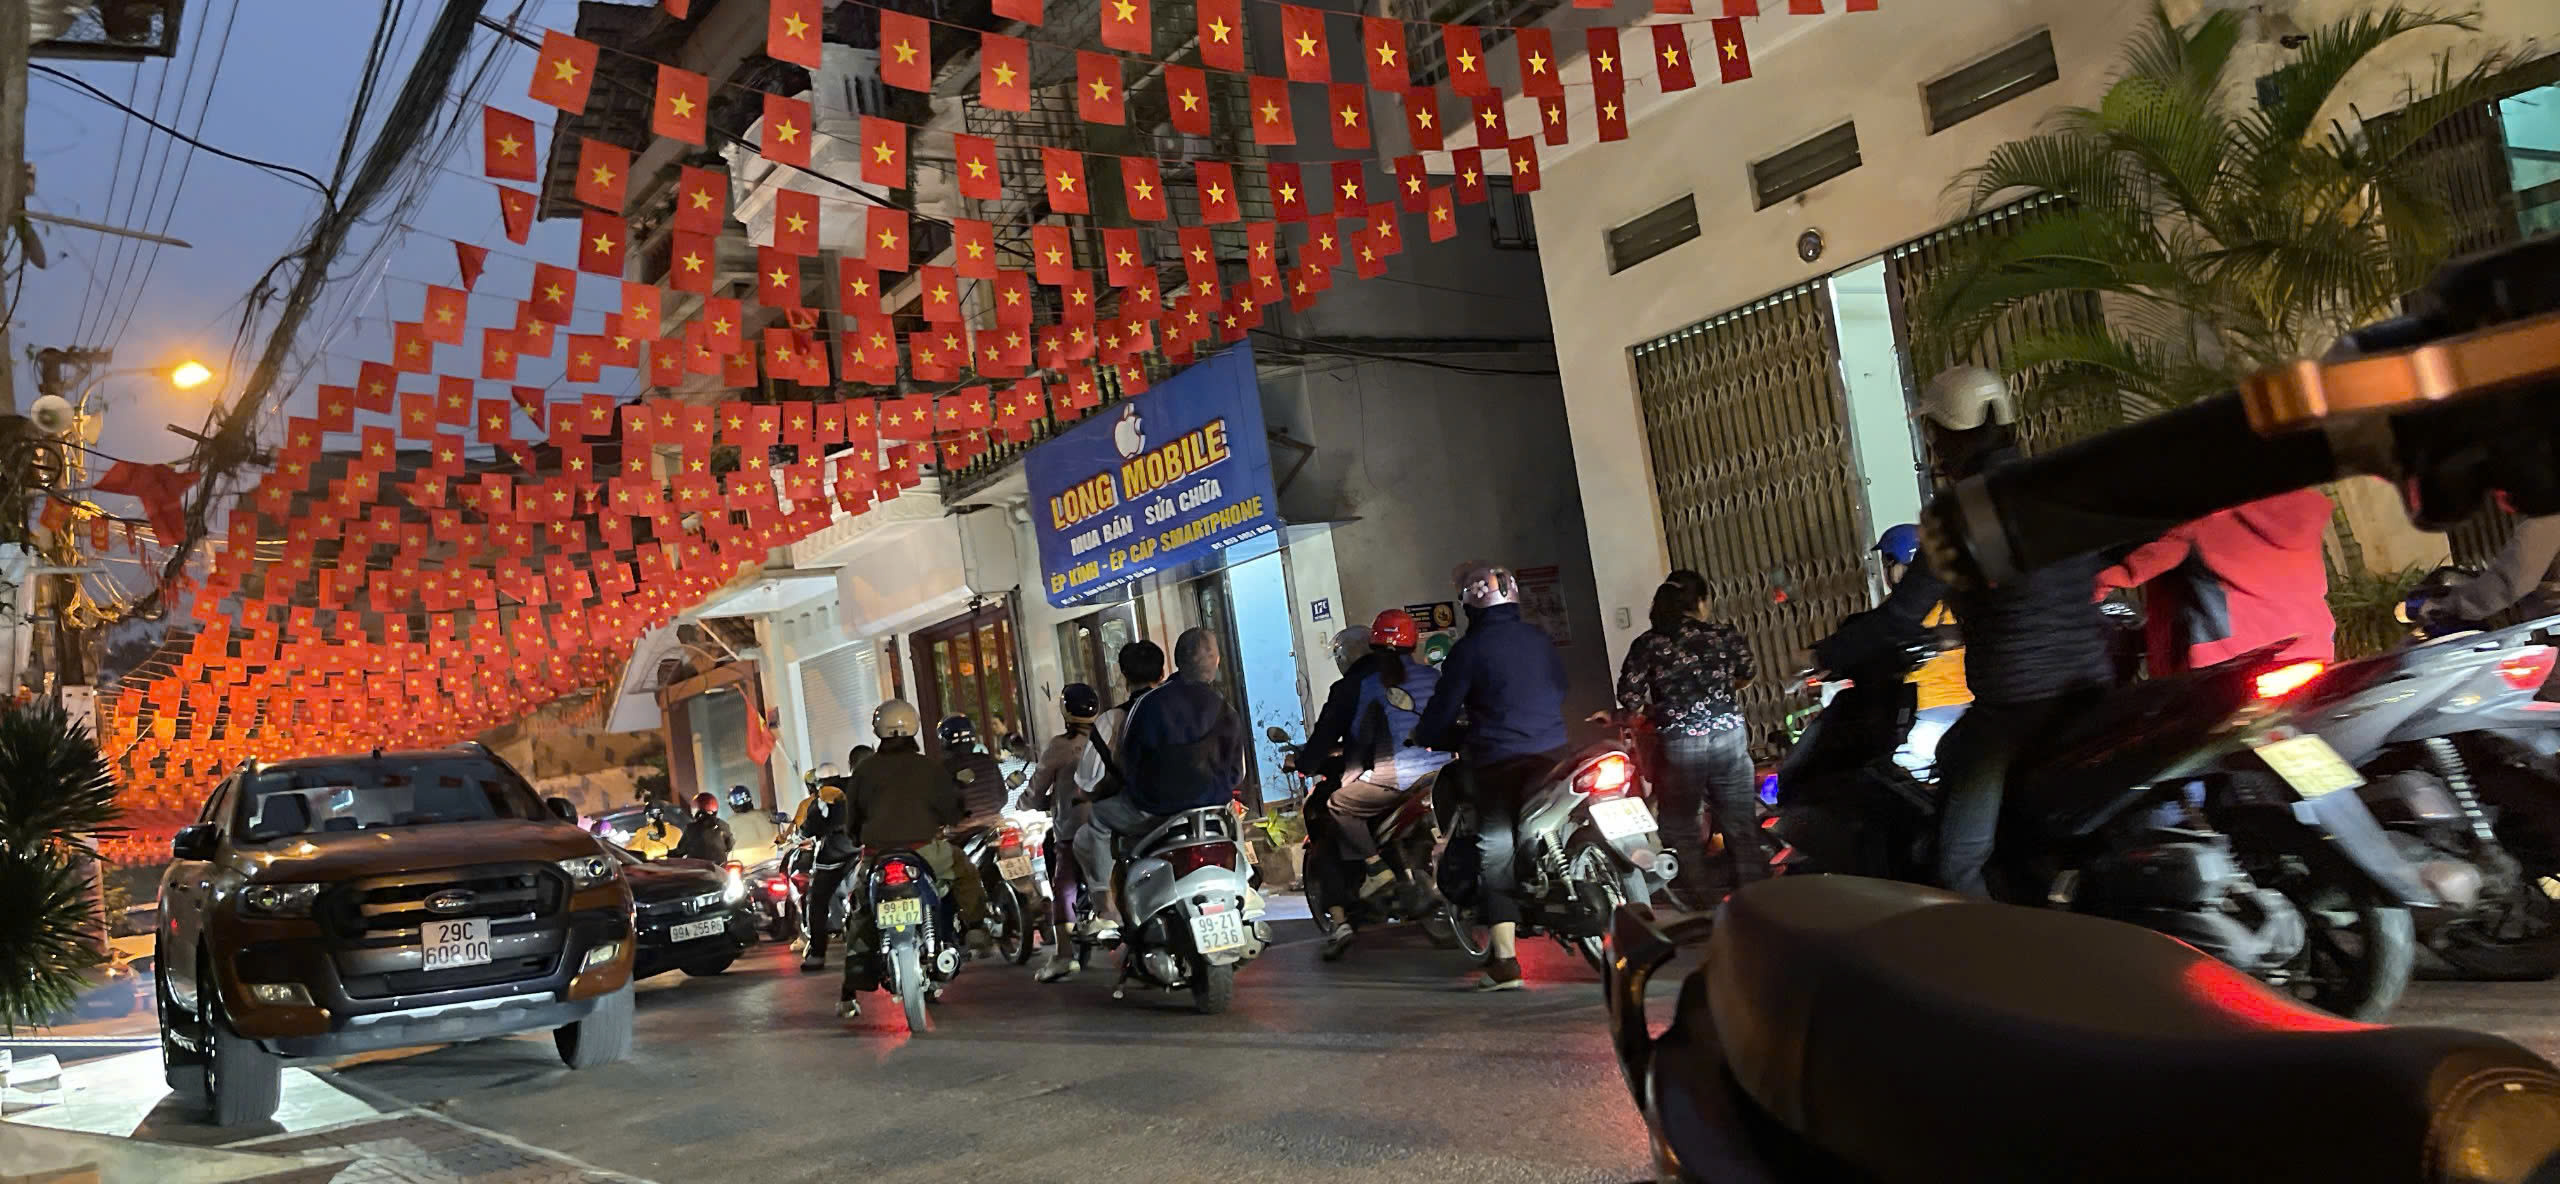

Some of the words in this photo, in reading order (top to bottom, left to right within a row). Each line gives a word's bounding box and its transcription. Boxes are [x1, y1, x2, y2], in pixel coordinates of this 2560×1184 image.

[1050, 472, 1118, 531] LONG
[1120, 419, 1230, 501] MOBILE
[1070, 530, 1102, 556] MUA
[1102, 515, 1134, 542] BÁN
[1145, 495, 1177, 525] SỬA
[1178, 478, 1223, 513] CHỮA
[1109, 547, 1127, 572] ÉP
[1160, 496, 1263, 552] SMARTPHONE
[439, 922, 474, 943] 29C
[1203, 929, 1239, 948] 5236
